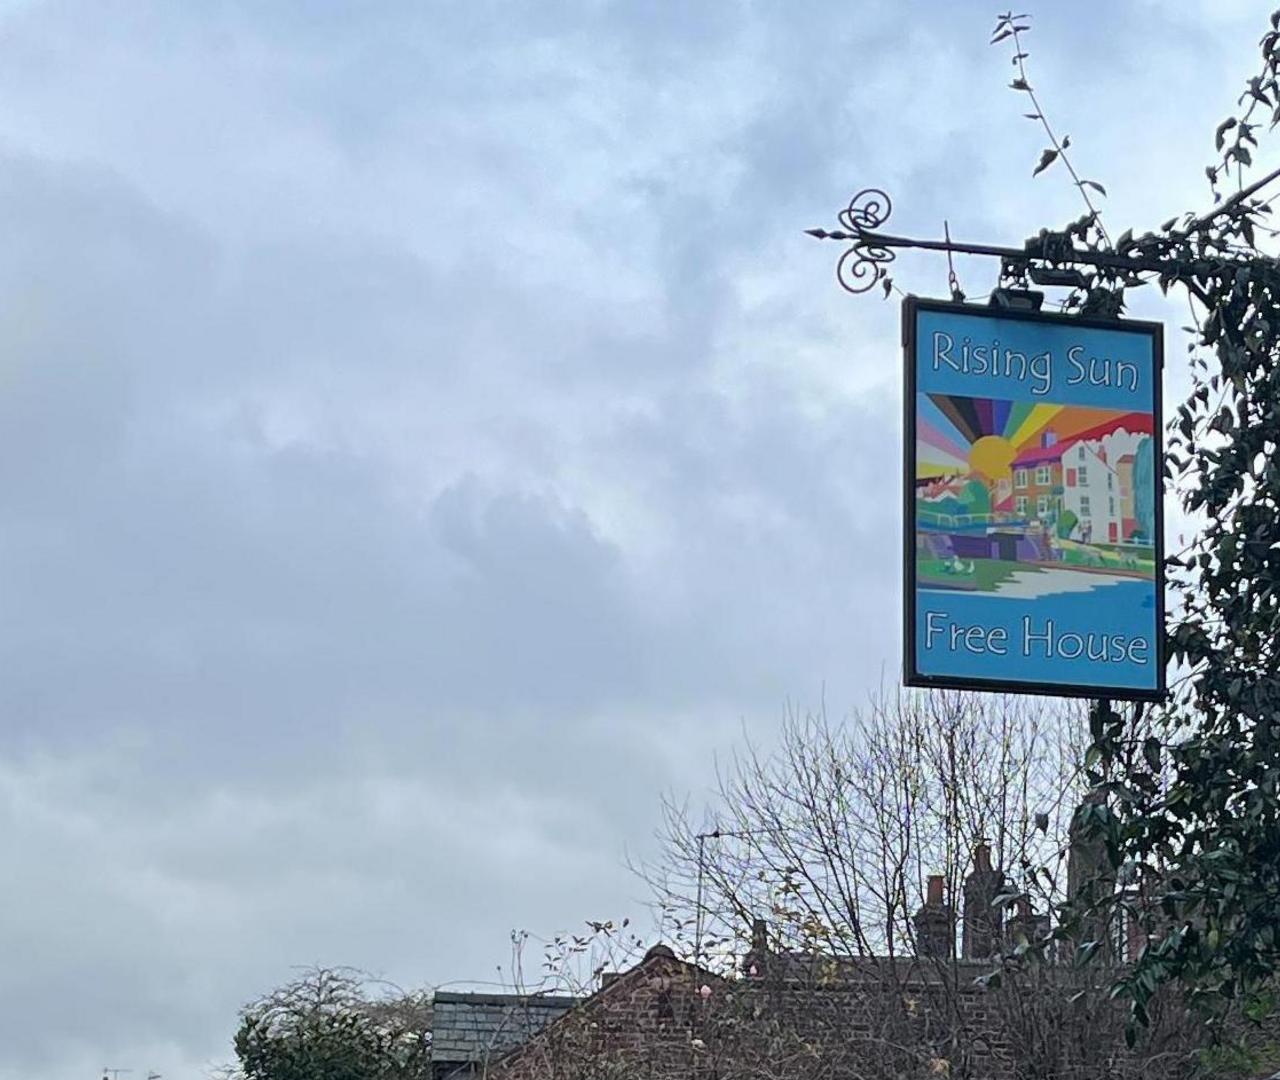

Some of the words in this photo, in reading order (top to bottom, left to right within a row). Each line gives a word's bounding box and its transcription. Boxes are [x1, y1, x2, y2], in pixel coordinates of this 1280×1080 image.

[931, 330, 1053, 396] Rising
[1066, 345, 1140, 392] Sun
[924, 611, 1008, 656] Free
[1022, 615, 1149, 665] House
